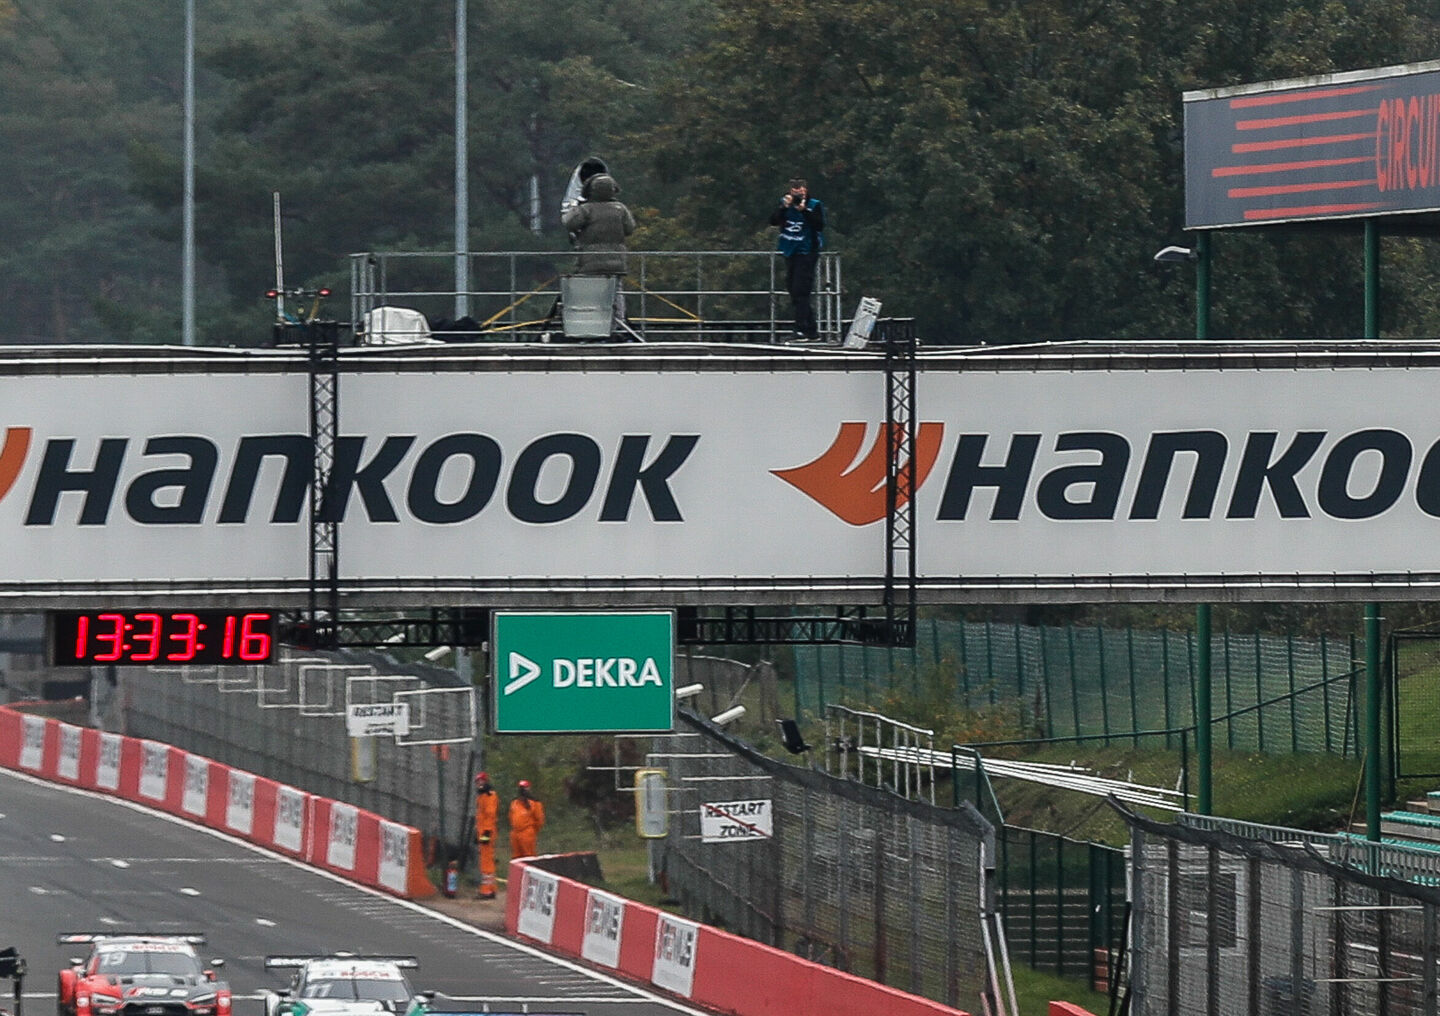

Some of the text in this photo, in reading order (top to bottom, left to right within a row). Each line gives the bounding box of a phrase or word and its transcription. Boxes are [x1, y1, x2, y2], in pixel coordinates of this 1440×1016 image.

[75, 612, 271, 662] 13:33:16
[552, 656, 663, 690] DEKRA
[101, 951, 128, 966] 19
